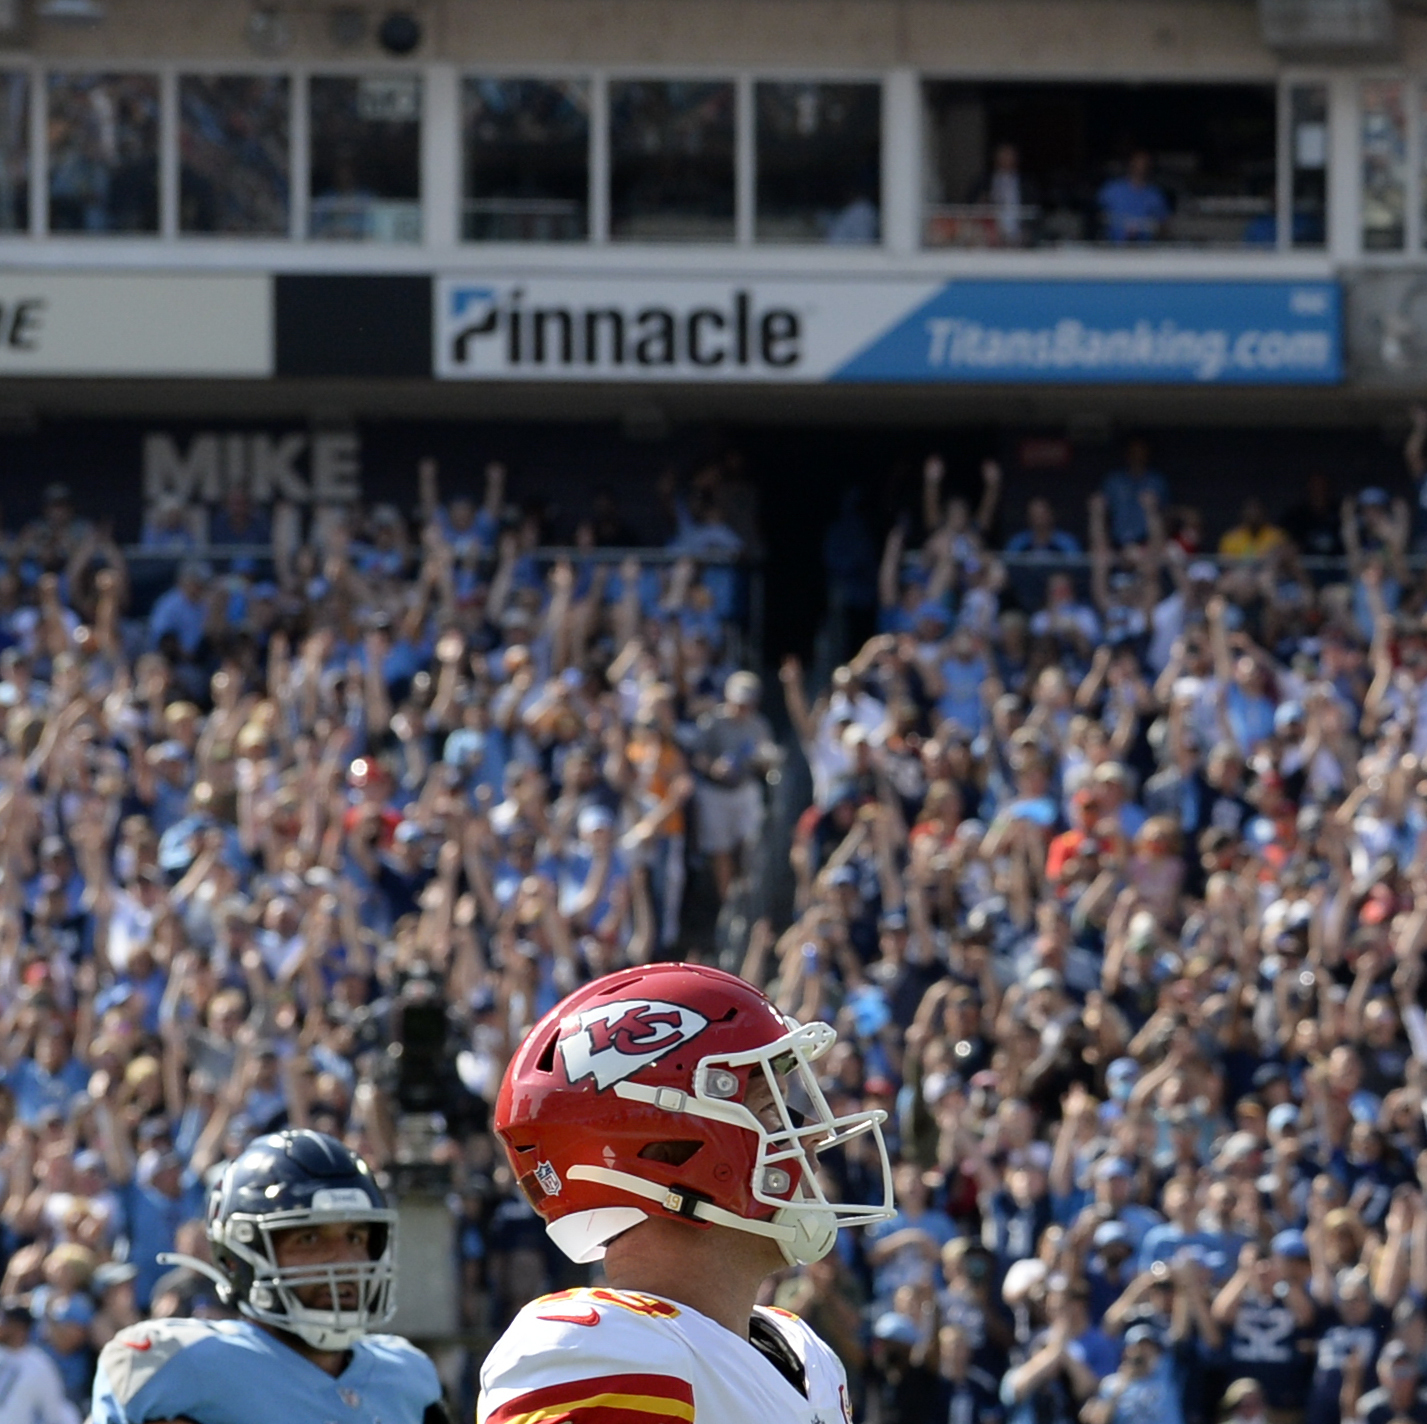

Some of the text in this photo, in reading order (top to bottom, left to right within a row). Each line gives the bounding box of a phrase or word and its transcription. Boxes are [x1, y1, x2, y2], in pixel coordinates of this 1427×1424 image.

[450, 286, 803, 368] Pinnacle
[924, 318, 1331, 380] TitansBanking.com
[142, 430, 361, 501] MIKE
[587, 1004, 683, 1057] KC
